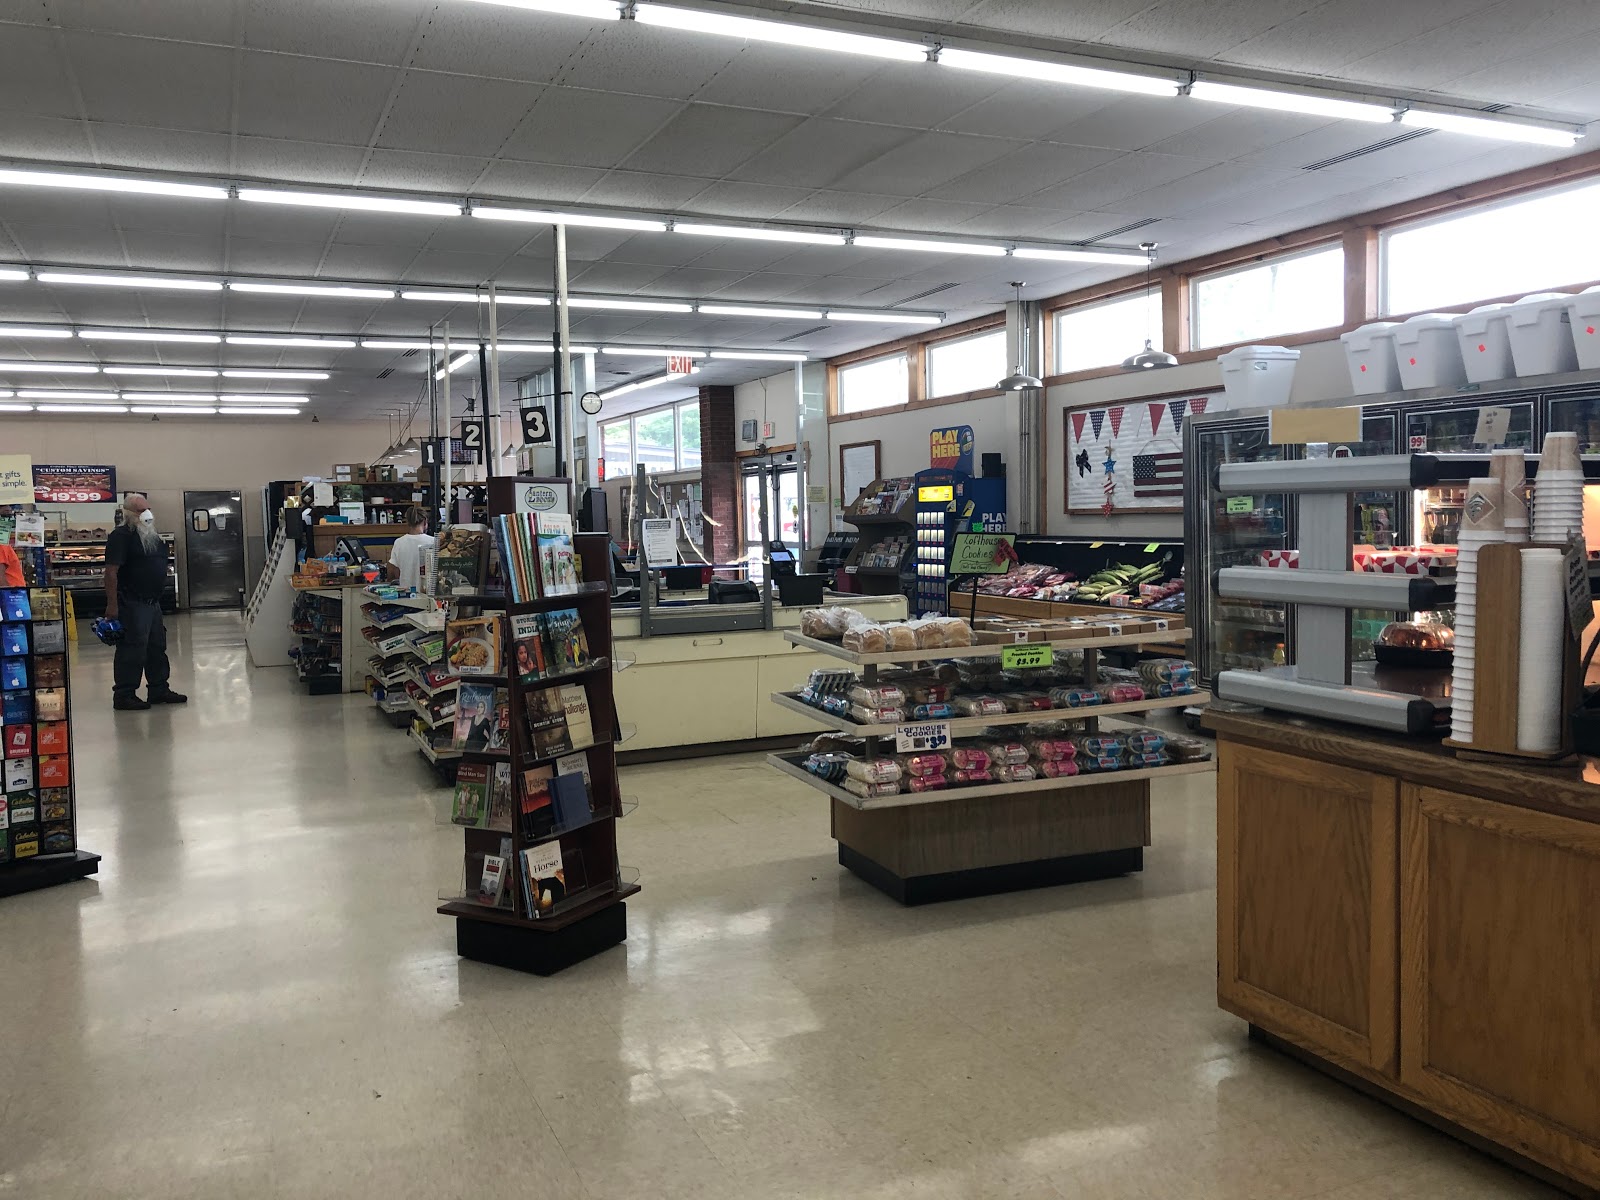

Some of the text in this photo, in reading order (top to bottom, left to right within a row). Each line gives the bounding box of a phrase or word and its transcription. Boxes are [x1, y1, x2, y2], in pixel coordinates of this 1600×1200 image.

[669, 356, 692, 372] EXIT
[526, 411, 546, 438] 3
[465, 424, 481, 447] 2
[932, 430, 958, 444] PLAY
[426, 444, 435, 464] 1
[932, 443, 961, 458] HERE
[5, 471, 21, 479] gifts
[2, 480, 27, 488] simple.
[42, 492, 102, 501] $19.99
[961, 546, 994, 559] Cookies
[1016, 657, 1041, 666] $3.99
[897, 724, 947, 734] LOFTHOUSE
[906, 729, 942, 738] COOKIES
[533, 860, 559, 874] Horse
